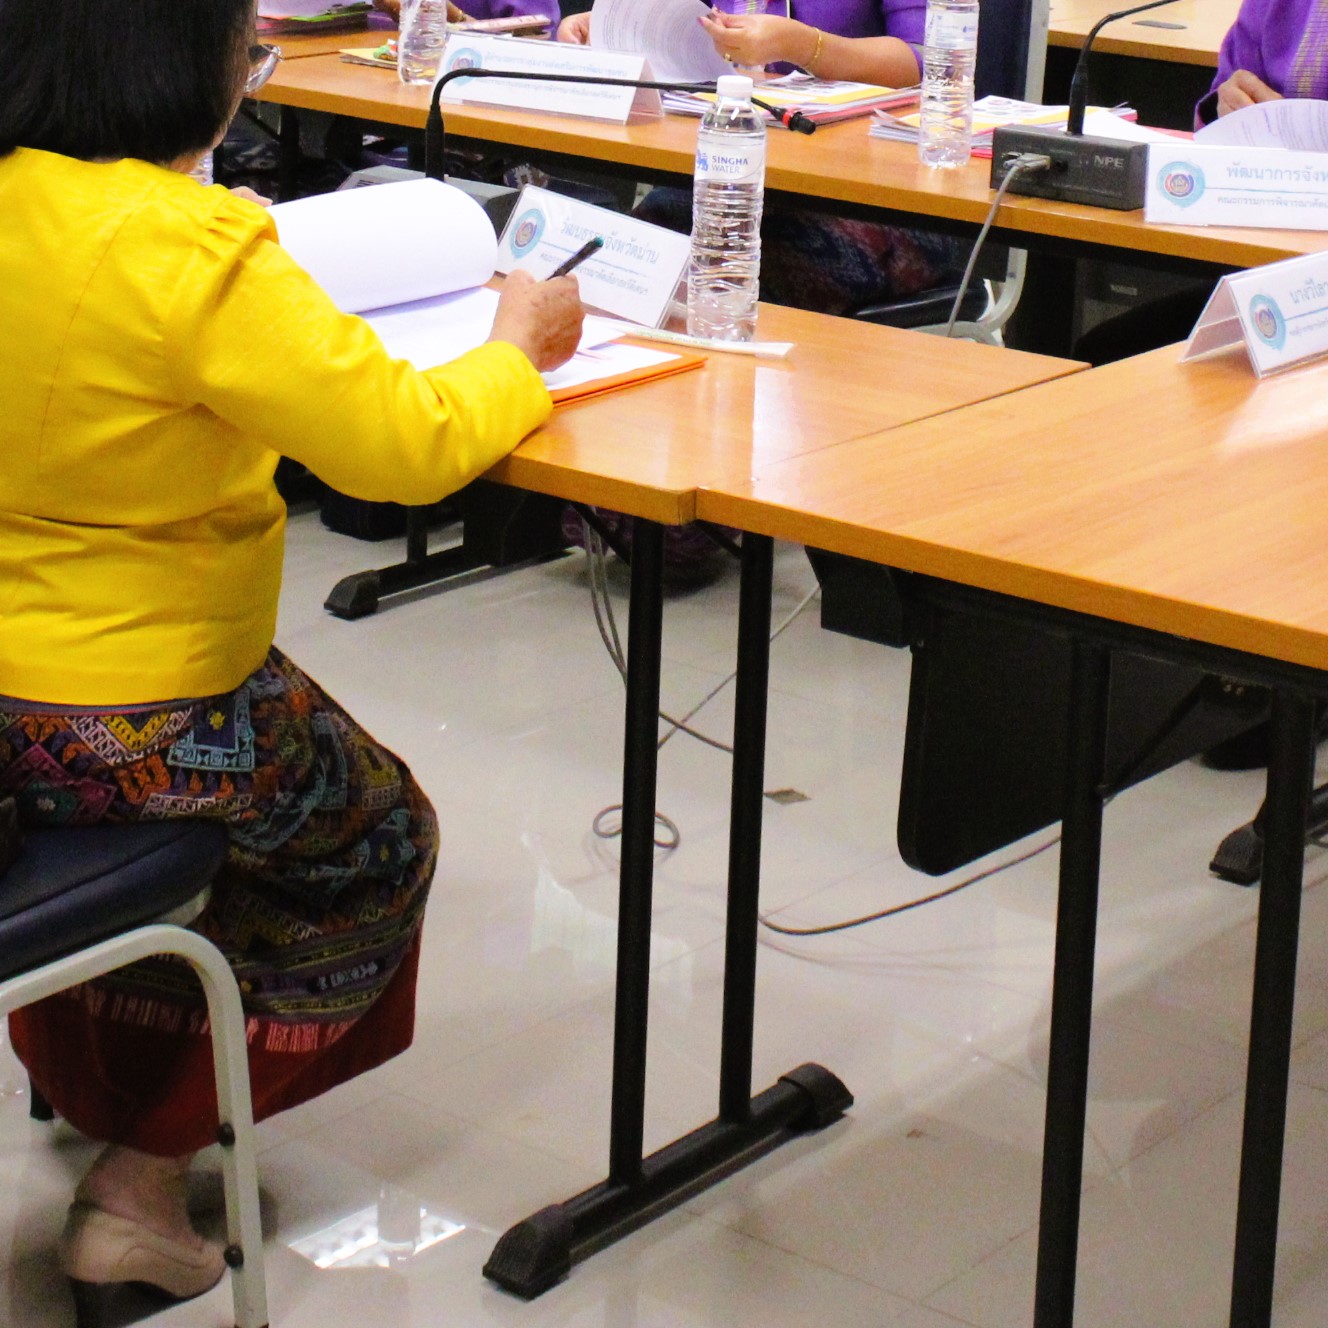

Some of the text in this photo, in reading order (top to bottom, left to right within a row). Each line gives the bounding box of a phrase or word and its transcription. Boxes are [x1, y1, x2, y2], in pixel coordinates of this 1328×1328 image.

[712, 155, 748, 165] SINGHA
[1094, 155, 1124, 168] NPE
[712, 164, 740, 173] WATER
